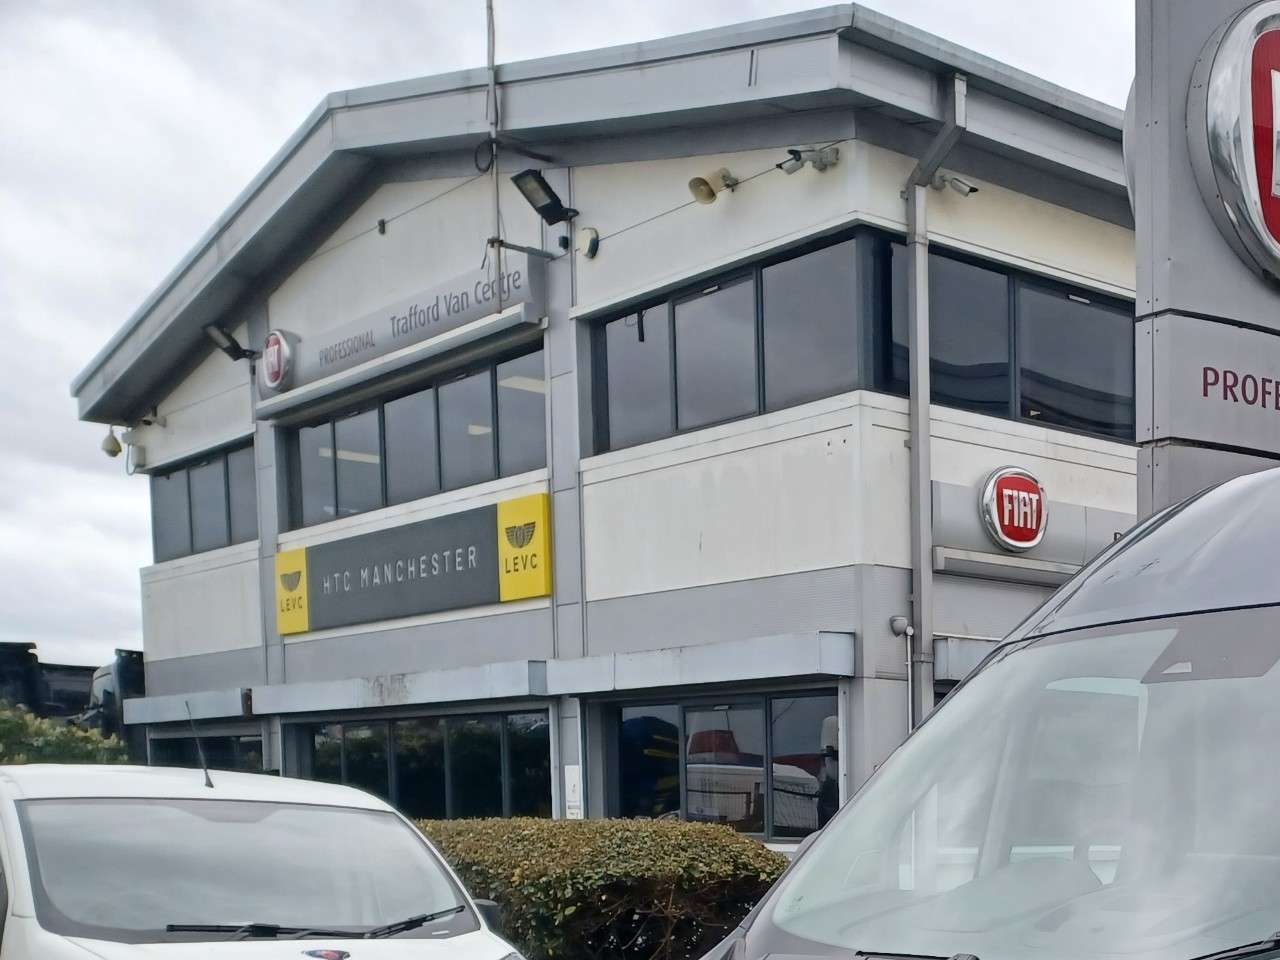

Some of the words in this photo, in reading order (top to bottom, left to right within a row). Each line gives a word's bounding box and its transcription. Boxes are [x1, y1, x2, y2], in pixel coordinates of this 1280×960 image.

[319, 330, 376, 368] PROFESSIONAL
[390, 295, 440, 339] Trafford
[444, 291, 470, 317] Van
[1003, 488, 1039, 530] FIAT
[323, 571, 351, 595] HTC
[360, 545, 477, 588] MANCHESTER
[505, 553, 538, 575] LEVC
[280, 597, 303, 613] LEVC
